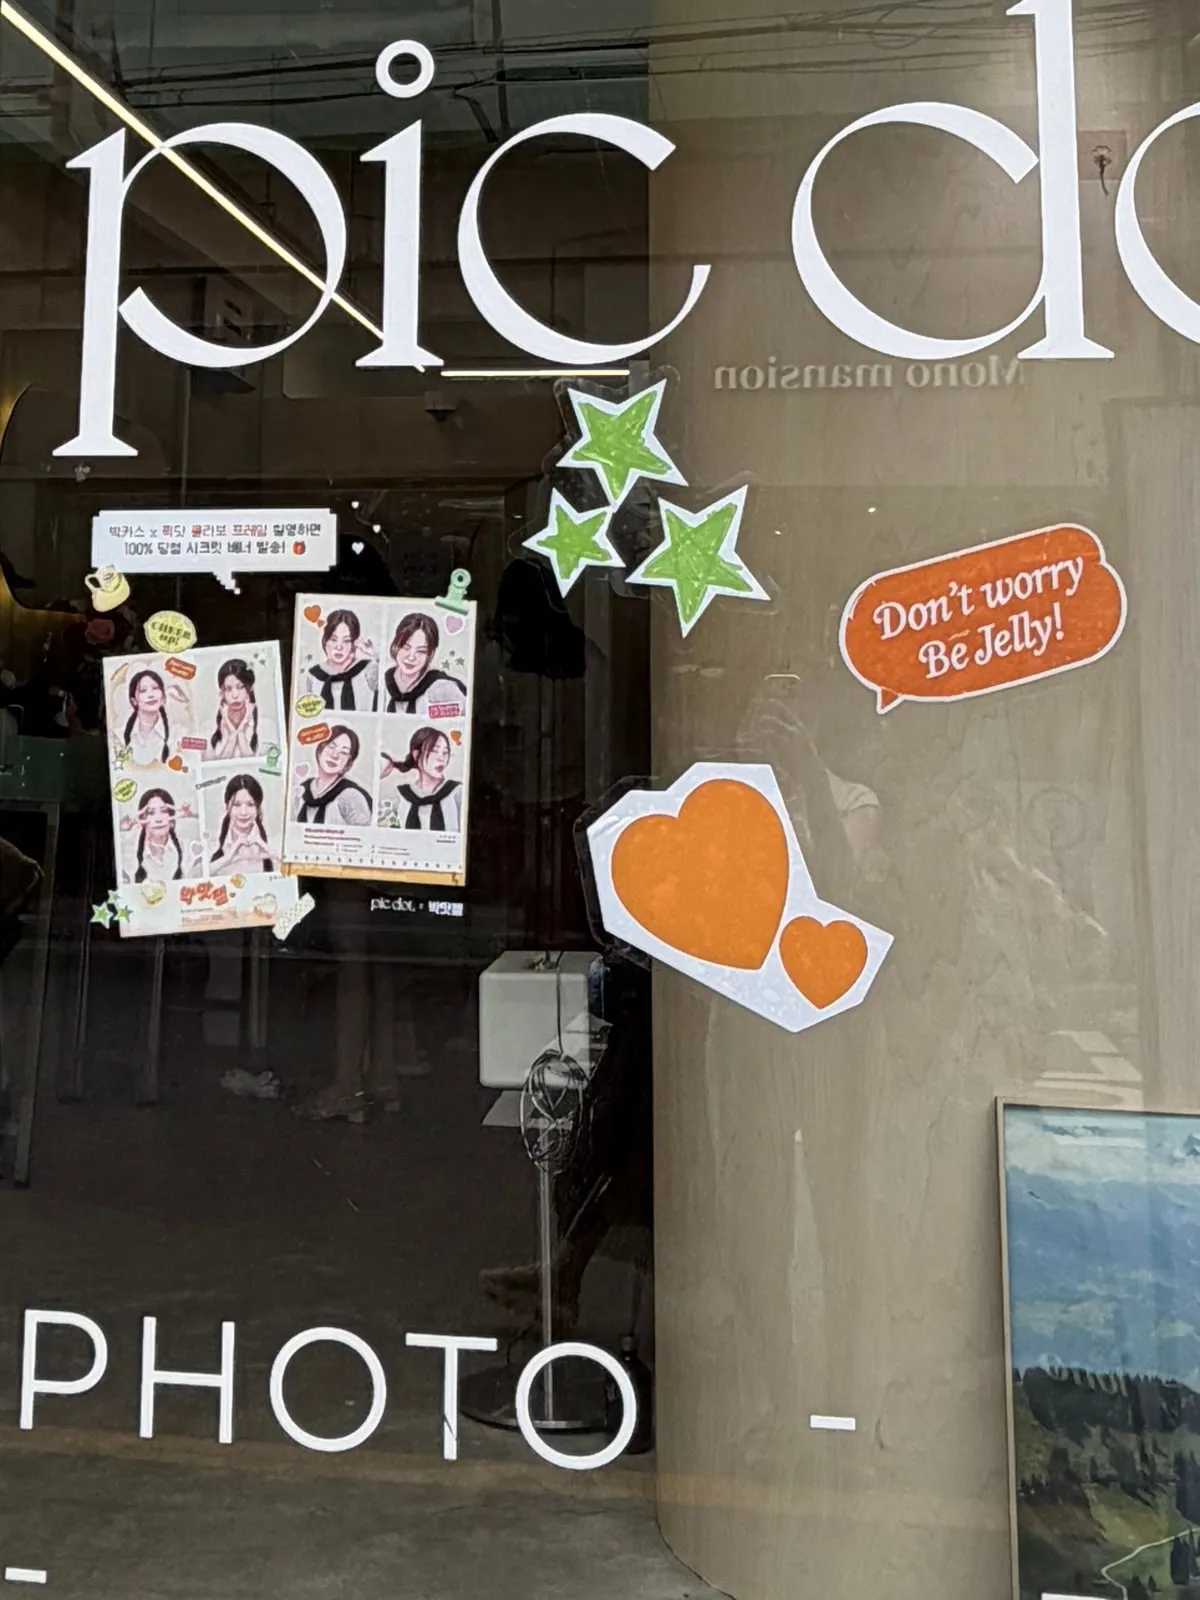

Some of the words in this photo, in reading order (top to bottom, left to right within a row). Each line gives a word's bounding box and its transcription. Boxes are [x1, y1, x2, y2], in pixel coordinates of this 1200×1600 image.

[109, 525, 145, 538] 박카스
[232, 524, 267, 537] 프레임
[124, 542, 153, 556] 100%
[186, 541, 222, 555] 시크릿
[227, 541, 251, 554] 배너
[873, 581, 973, 640] Don't
[979, 556, 1084, 608] worry
[918, 639, 970, 679] Be
[974, 602, 1065, 665] Jelly!
[20, 1309, 637, 1470] PHOTO
